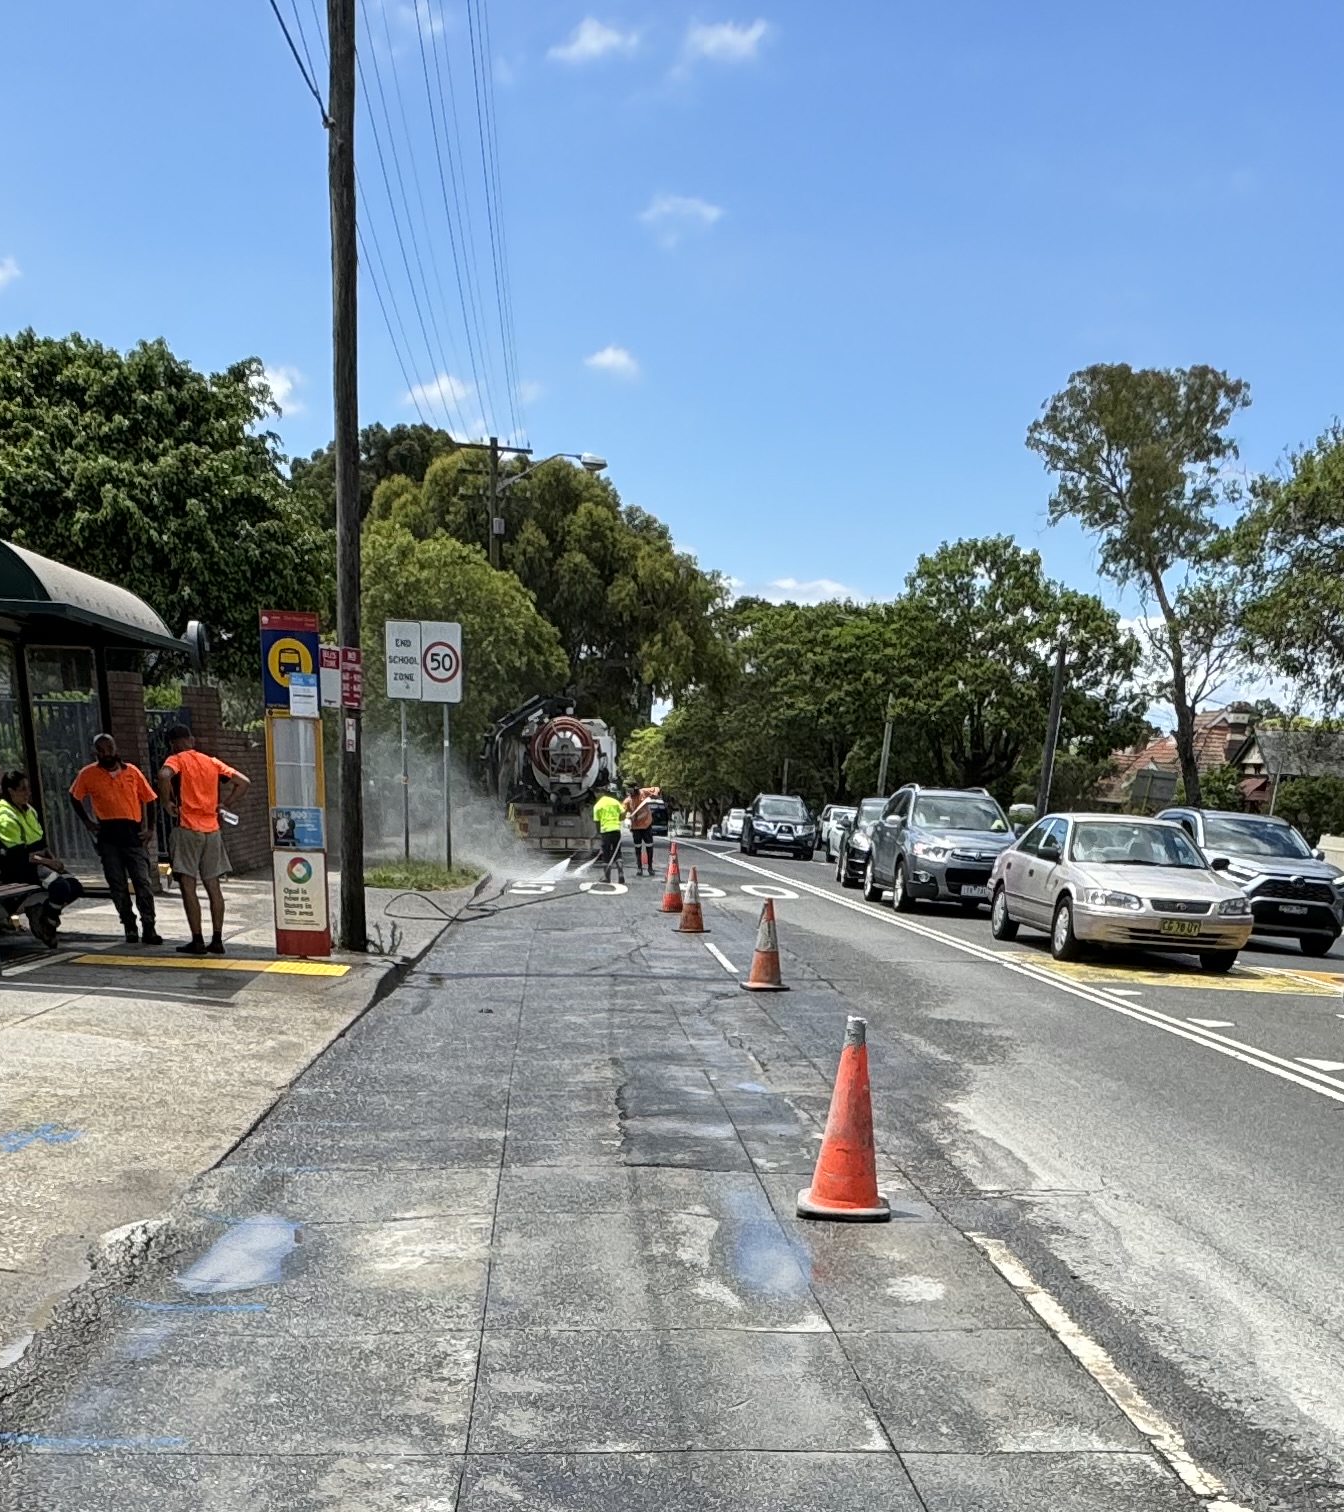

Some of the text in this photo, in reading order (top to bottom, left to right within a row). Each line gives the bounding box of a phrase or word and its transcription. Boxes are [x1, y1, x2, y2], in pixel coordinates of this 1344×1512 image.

[388, 655, 420, 665] SCHOOL
[430, 652, 453, 672] 50
[393, 672, 415, 681] ZONE
